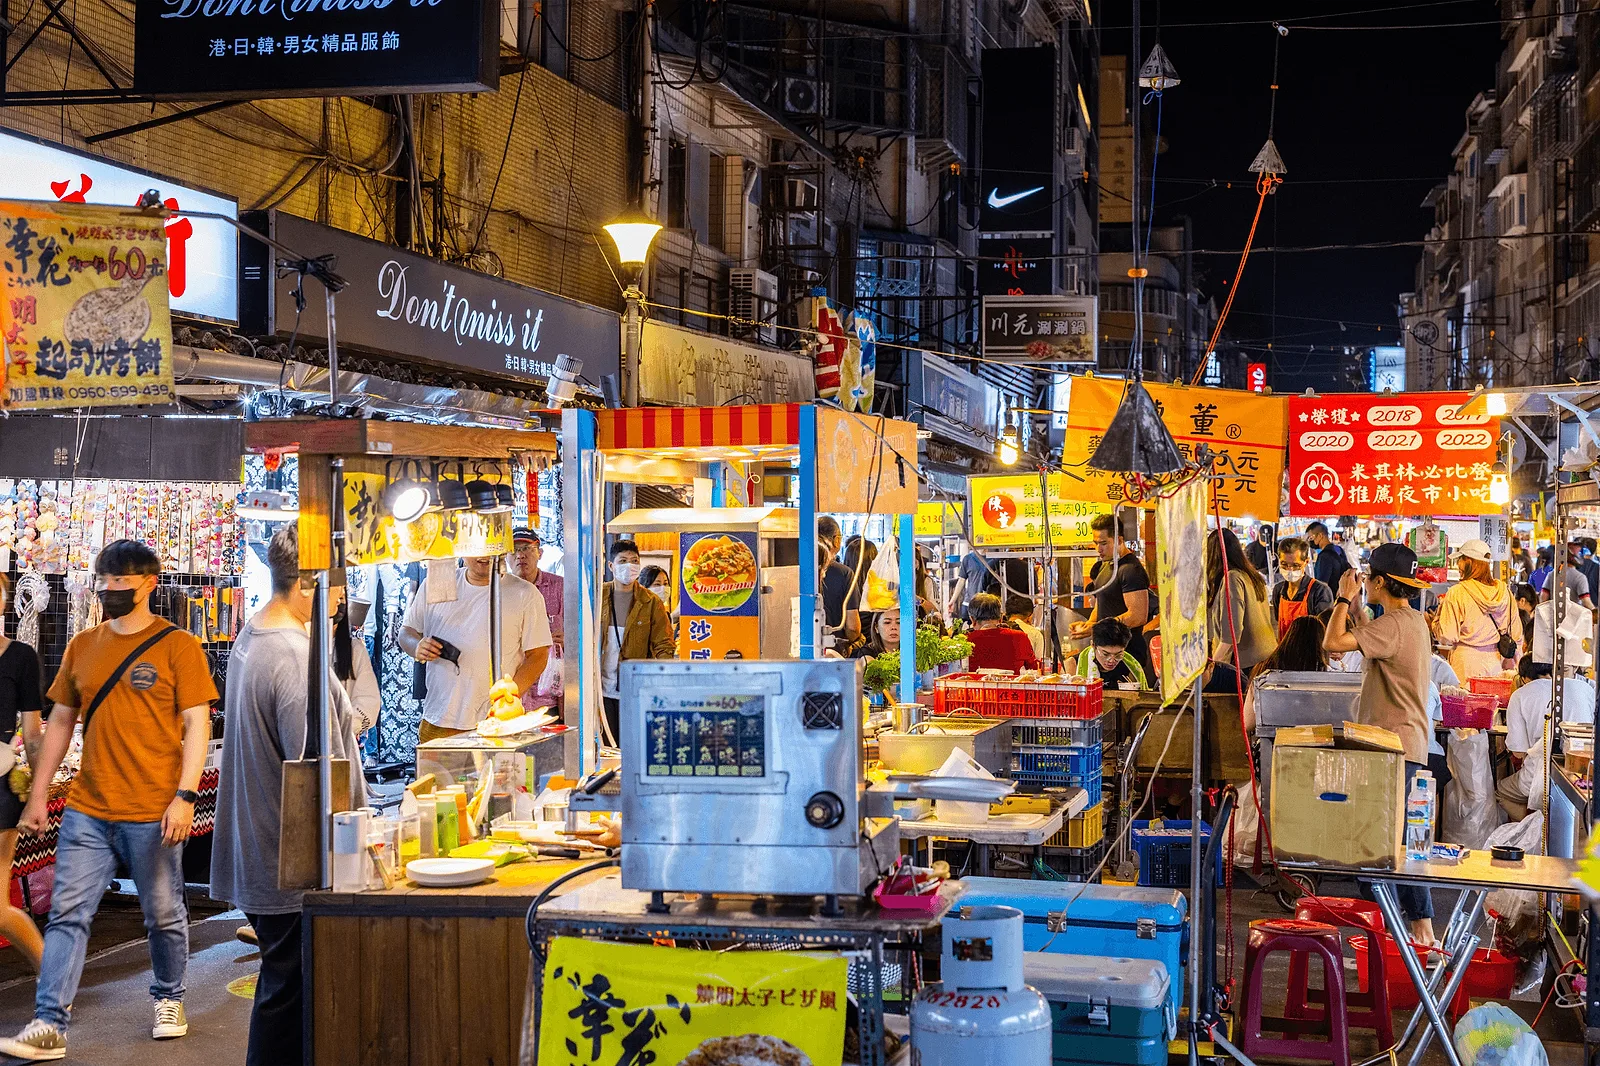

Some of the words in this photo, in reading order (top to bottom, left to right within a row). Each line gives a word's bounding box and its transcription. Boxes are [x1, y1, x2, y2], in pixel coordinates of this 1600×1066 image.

[377, 260, 456, 333] Don't
[454, 298, 516, 346] miss
[521, 309, 543, 352] it
[991, 312, 1033, 336] 川元
[34, 336, 162, 380] 起司烤餅
[1310, 408, 1351, 426] 榮獲
[1373, 410, 1415, 422] 2018
[1305, 435, 1349, 447] 2020
[1373, 435, 1417, 447] 2021
[1441, 433, 1488, 446] 2022
[1350, 463, 1491, 482] 米其林必比登
[692, 581, 754, 594] Shawarma
